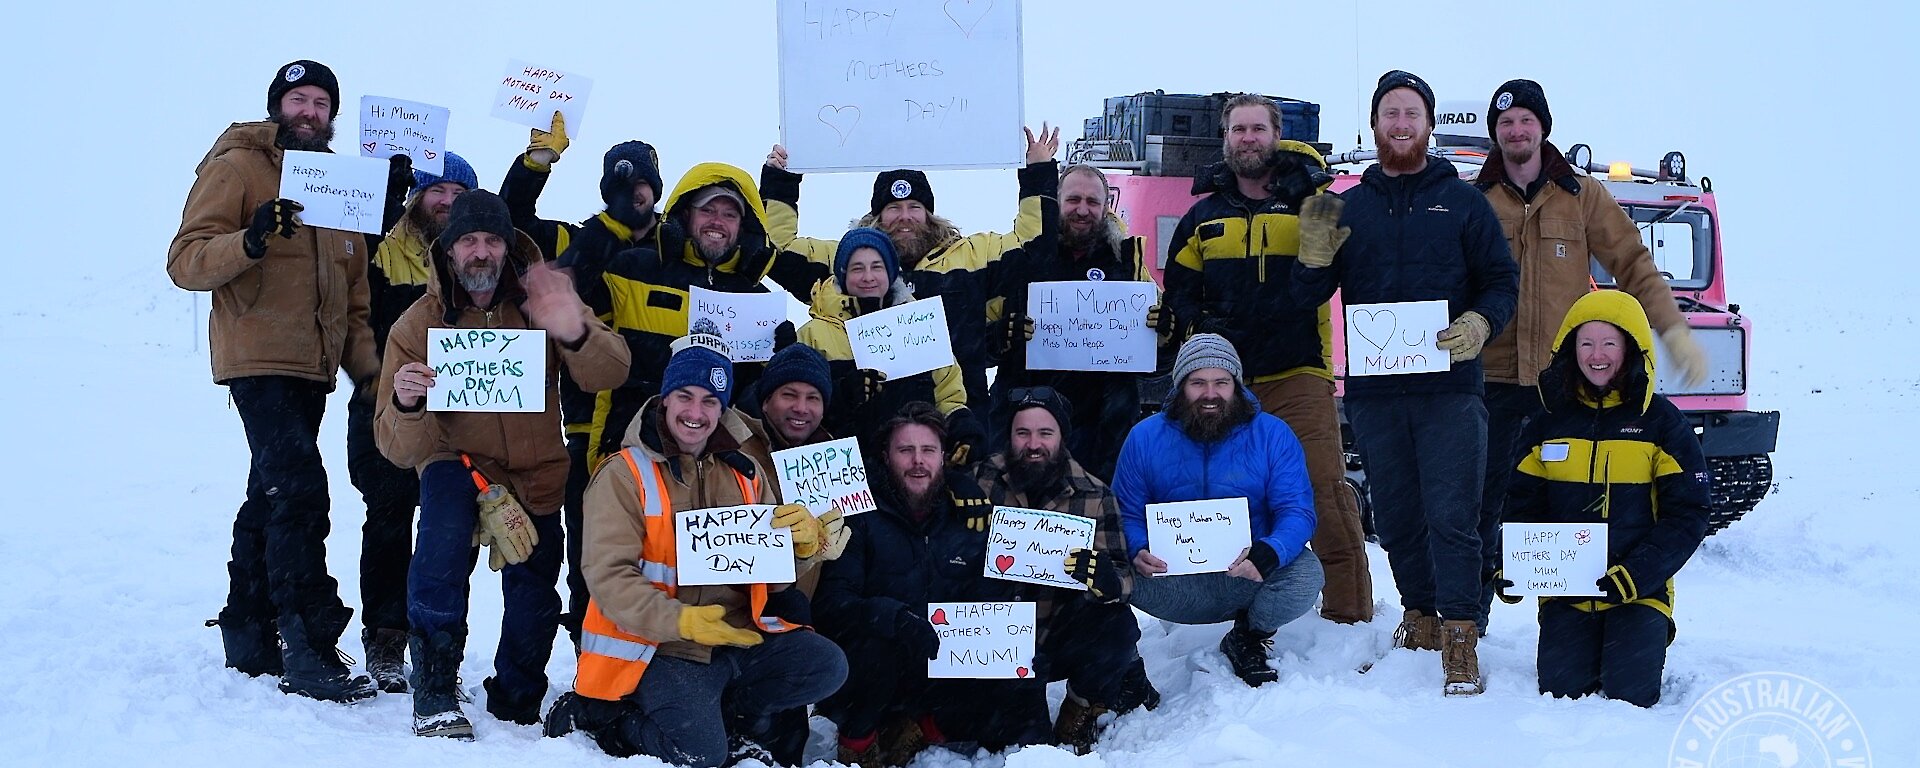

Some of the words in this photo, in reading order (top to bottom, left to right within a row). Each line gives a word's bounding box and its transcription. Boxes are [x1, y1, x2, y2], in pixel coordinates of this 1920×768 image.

[803, 1, 897, 41] HAPPY
[522, 66, 564, 84] HAPPY
[846, 59, 944, 82] MOTHERS
[508, 95, 539, 113] MUM
[549, 90, 573, 103] DAY
[371, 104, 385, 118] Hi
[1436, 112, 1477, 125] MRAD
[364, 123, 396, 141] Happy
[403, 127, 435, 144] Mothers
[292, 165, 328, 179] Happy
[303, 182, 348, 198] Mothers
[351, 188, 375, 202] Day
[698, 299, 737, 319] HUGS
[1040, 288, 1059, 314] Hi
[1076, 288, 1127, 315] Mum
[857, 322, 893, 341] Happy
[1034, 318, 1063, 337] Happy
[1068, 317, 1103, 332] Mothers
[439, 330, 520, 353] HAPPY
[867, 344, 896, 361] Day
[903, 325, 936, 348] Mum!
[1042, 338, 1060, 349] Miss
[1063, 338, 1078, 348] You
[1082, 337, 1105, 350] Heaps
[435, 358, 524, 377] MOTHERS
[1091, 355, 1110, 365] Love
[465, 376, 496, 393] DAY
[446, 385, 523, 409] MUM
[783, 447, 853, 481] HAPPY
[685, 509, 768, 532] HAPPY
[995, 512, 1026, 530] Happy
[1033, 517, 1085, 538] Mother's
[1156, 511, 1182, 529] Happy
[1216, 512, 1232, 526] Day
[691, 530, 785, 552] MOTHER'S
[992, 532, 1017, 550] Day
[1026, 541, 1069, 557] Mum!
[1175, 533, 1195, 545] Mum
[1524, 530, 1561, 546] HAPPY
[705, 554, 755, 575] DAY
[1511, 550, 1551, 562] MOTHERS
[1560, 549, 1577, 562] DAY
[1025, 564, 1055, 580] John
[1534, 567, 1558, 576] MUM
[955, 602, 1013, 619] HAPPY
[1006, 623, 1034, 636] DAY
[950, 646, 1019, 667] MUM!
